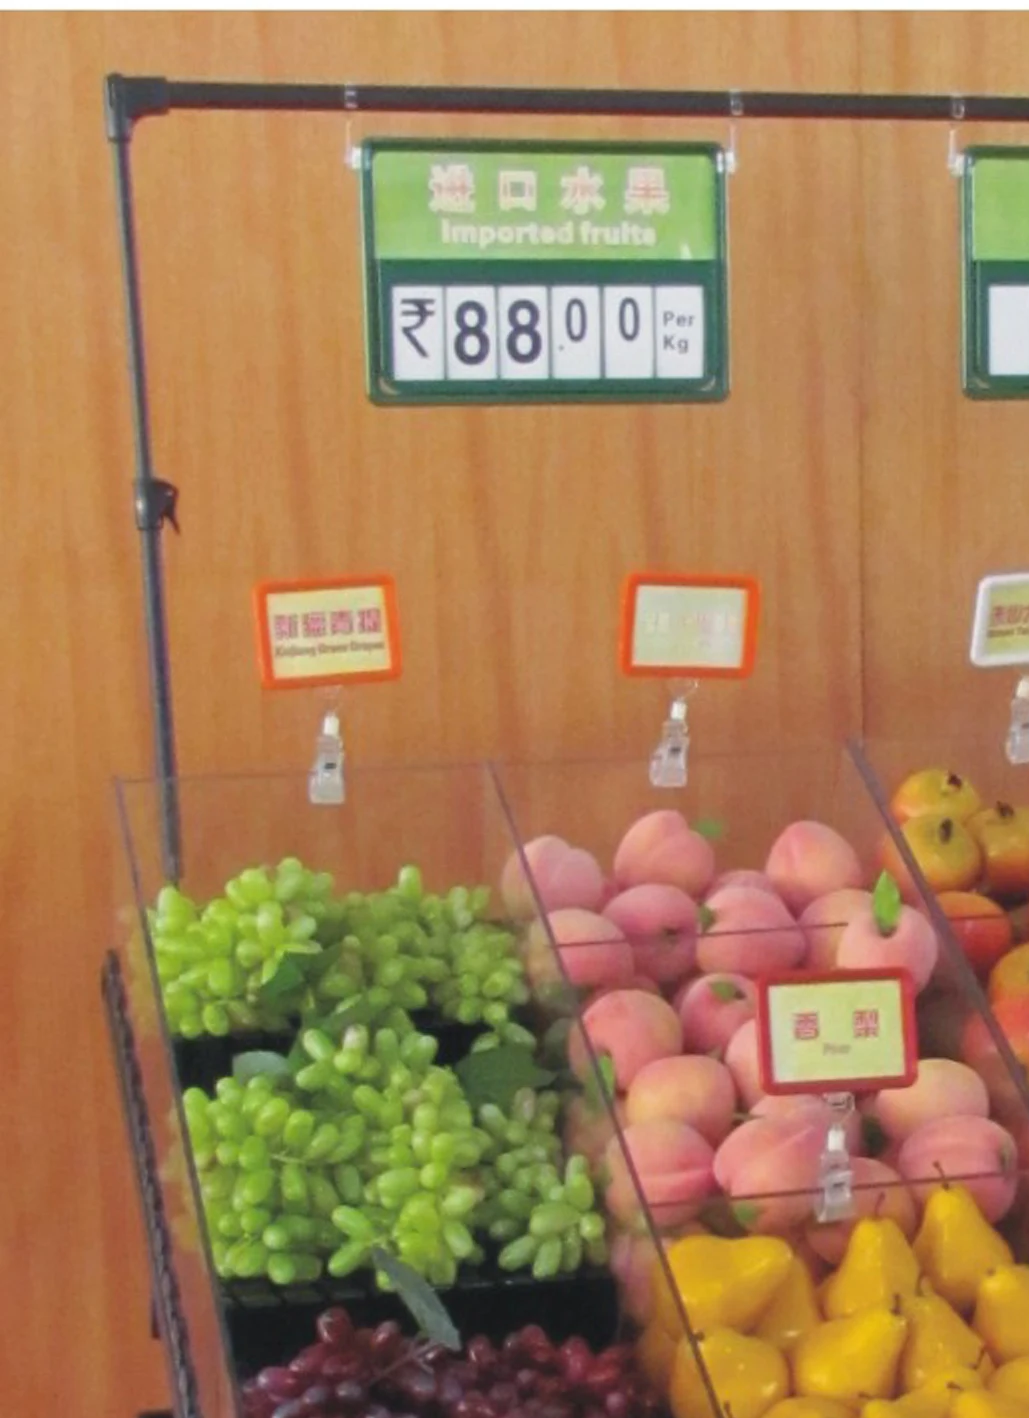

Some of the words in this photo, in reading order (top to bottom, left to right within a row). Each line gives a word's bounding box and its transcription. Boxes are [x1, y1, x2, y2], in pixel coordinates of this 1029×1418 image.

[441, 219, 574, 248] Imported
[580, 220, 656, 247] fruits
[663, 311, 696, 328] Per
[663, 337, 689, 354] Kg
